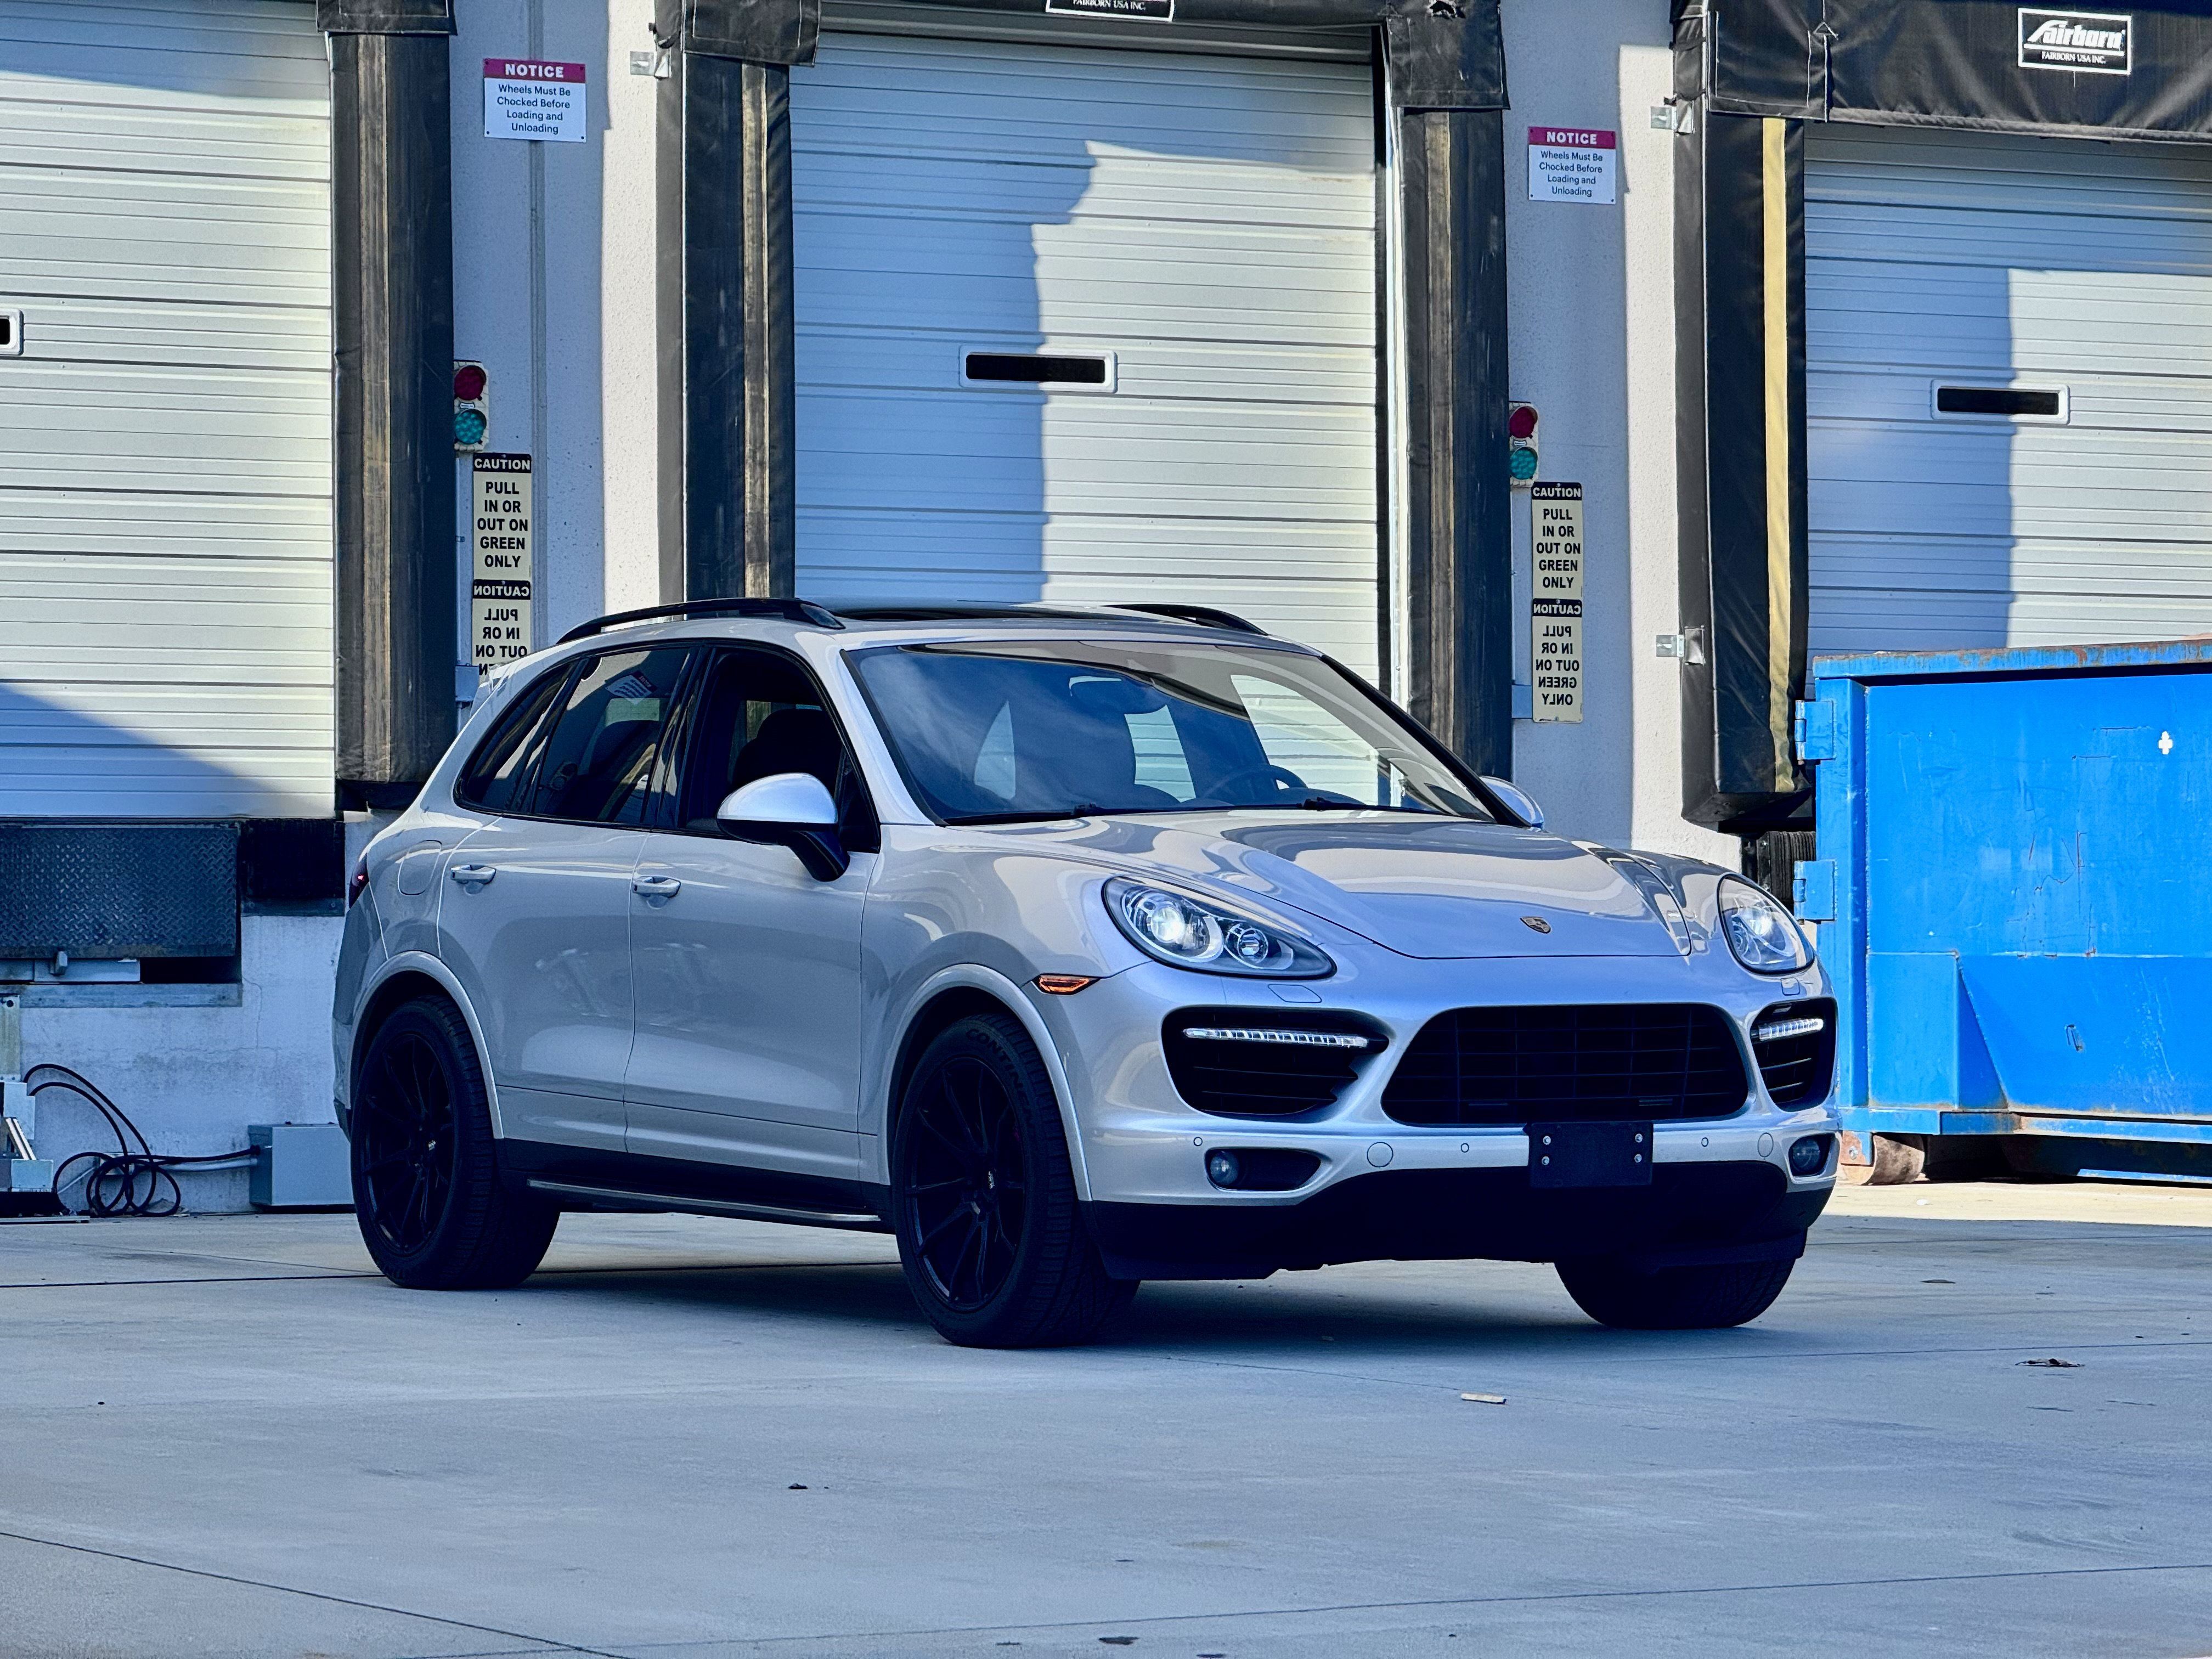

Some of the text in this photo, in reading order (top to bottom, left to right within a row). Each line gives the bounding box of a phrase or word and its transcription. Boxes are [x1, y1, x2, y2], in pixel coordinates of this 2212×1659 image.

[1113, 0, 1129, 9] USA
[2027, 20, 2123, 50] Fairborn
[2041, 51, 2075, 61] FAIRBORN
[2077, 54, 2091, 63] USA
[505, 63, 564, 78] NOTICE
[498, 84, 571, 96] Wheels Must Be
[497, 96, 571, 109] Chocked Before
[507, 110, 563, 121] Loading and
[511, 123, 558, 134] Unloading
[1547, 131, 1598, 145] NOTICE
[1541, 150, 1603, 161] Wheels Must Be
[1539, 162, 1602, 173] Chocked Before
[1548, 174, 1596, 185] Loading and
[1551, 185, 1592, 197] Unloading
[474, 458, 531, 470] CAUTION
[486, 481, 520, 494] PULL
[1533, 487, 1581, 498] CAUTION
[484, 499, 521, 513] IN OR
[1543, 508, 1573, 520] PULL
[477, 517, 528, 531] OUT ON
[1542, 525, 1575, 537] IN OR
[480, 536, 525, 550] GREEN
[1536, 542, 1581, 554] OUT ON
[484, 554, 521, 568] ONLY
[1538, 560, 1578, 572] GREEN
[1542, 577, 1575, 589] ONLY
